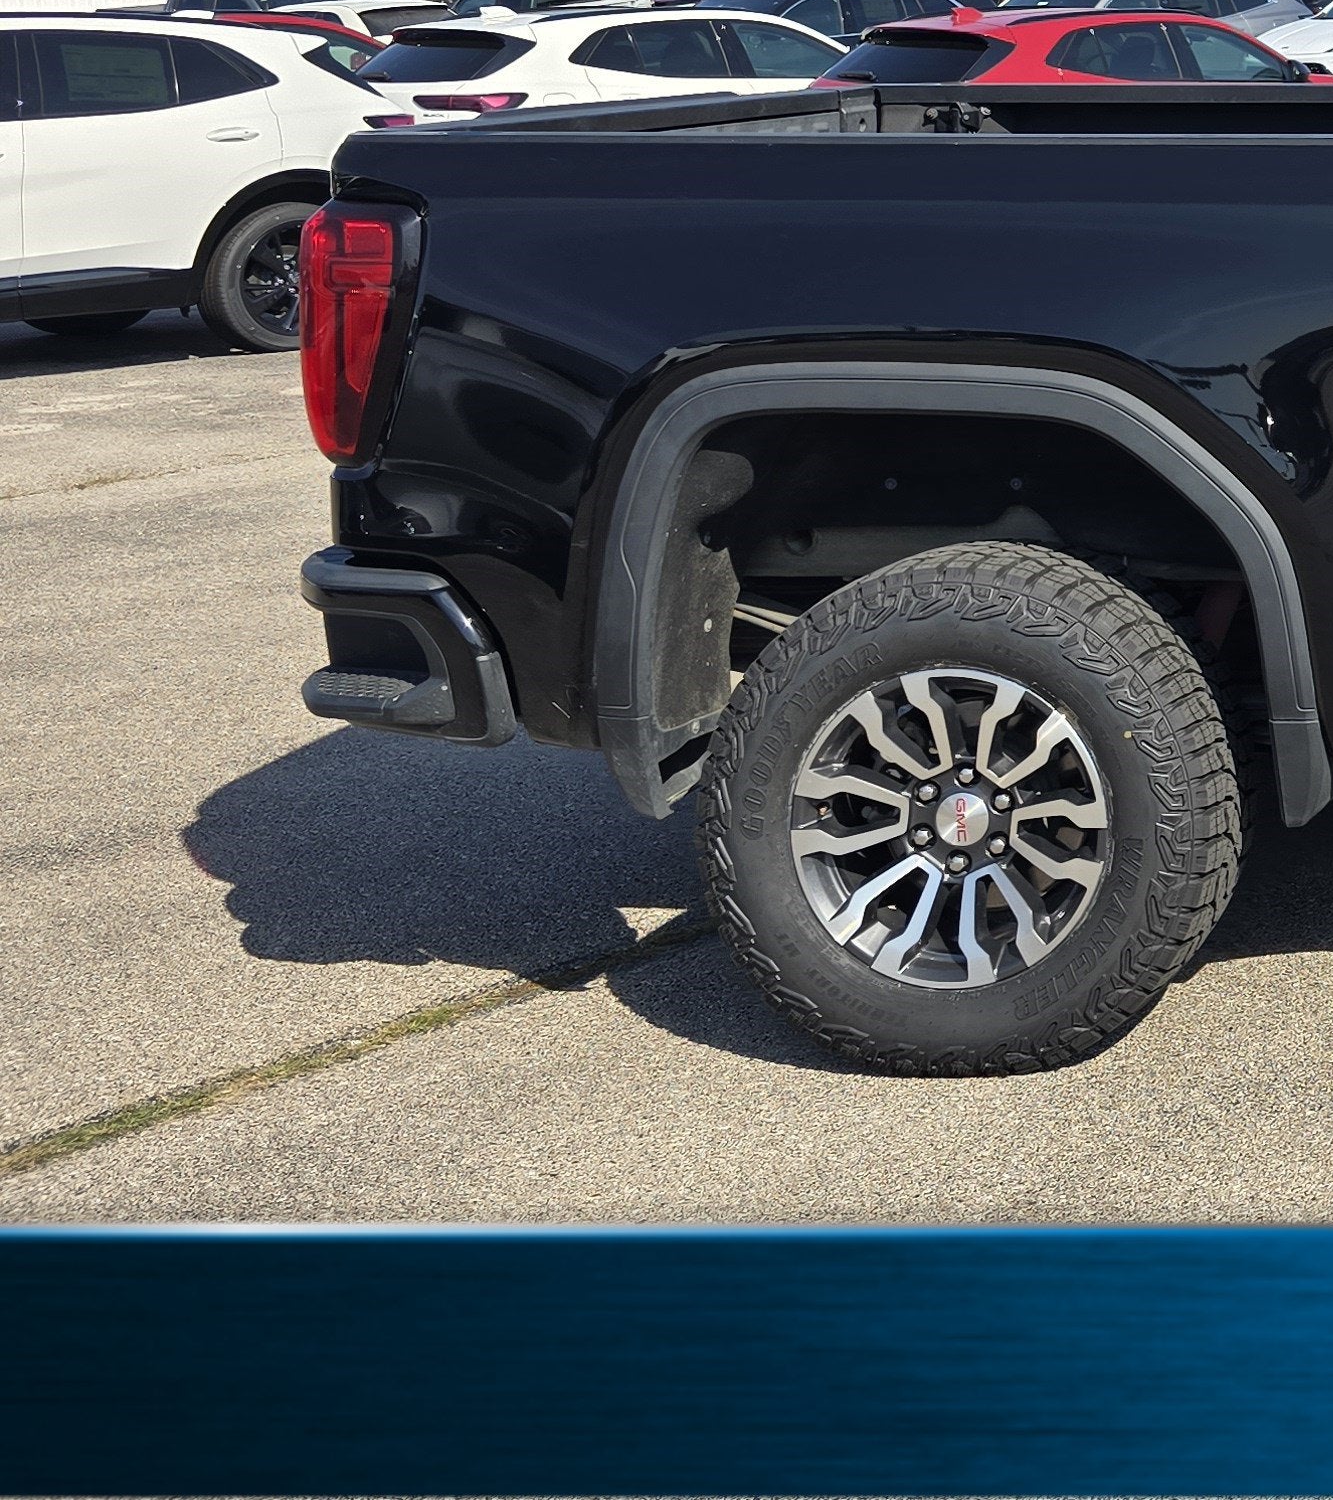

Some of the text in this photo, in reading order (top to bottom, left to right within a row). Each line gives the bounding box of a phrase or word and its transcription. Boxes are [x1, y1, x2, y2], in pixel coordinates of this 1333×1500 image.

[740, 641, 883, 841] GOODYEAR
[955, 797, 968, 842] GMC
[1011, 838, 1145, 1021] WRANGLER
